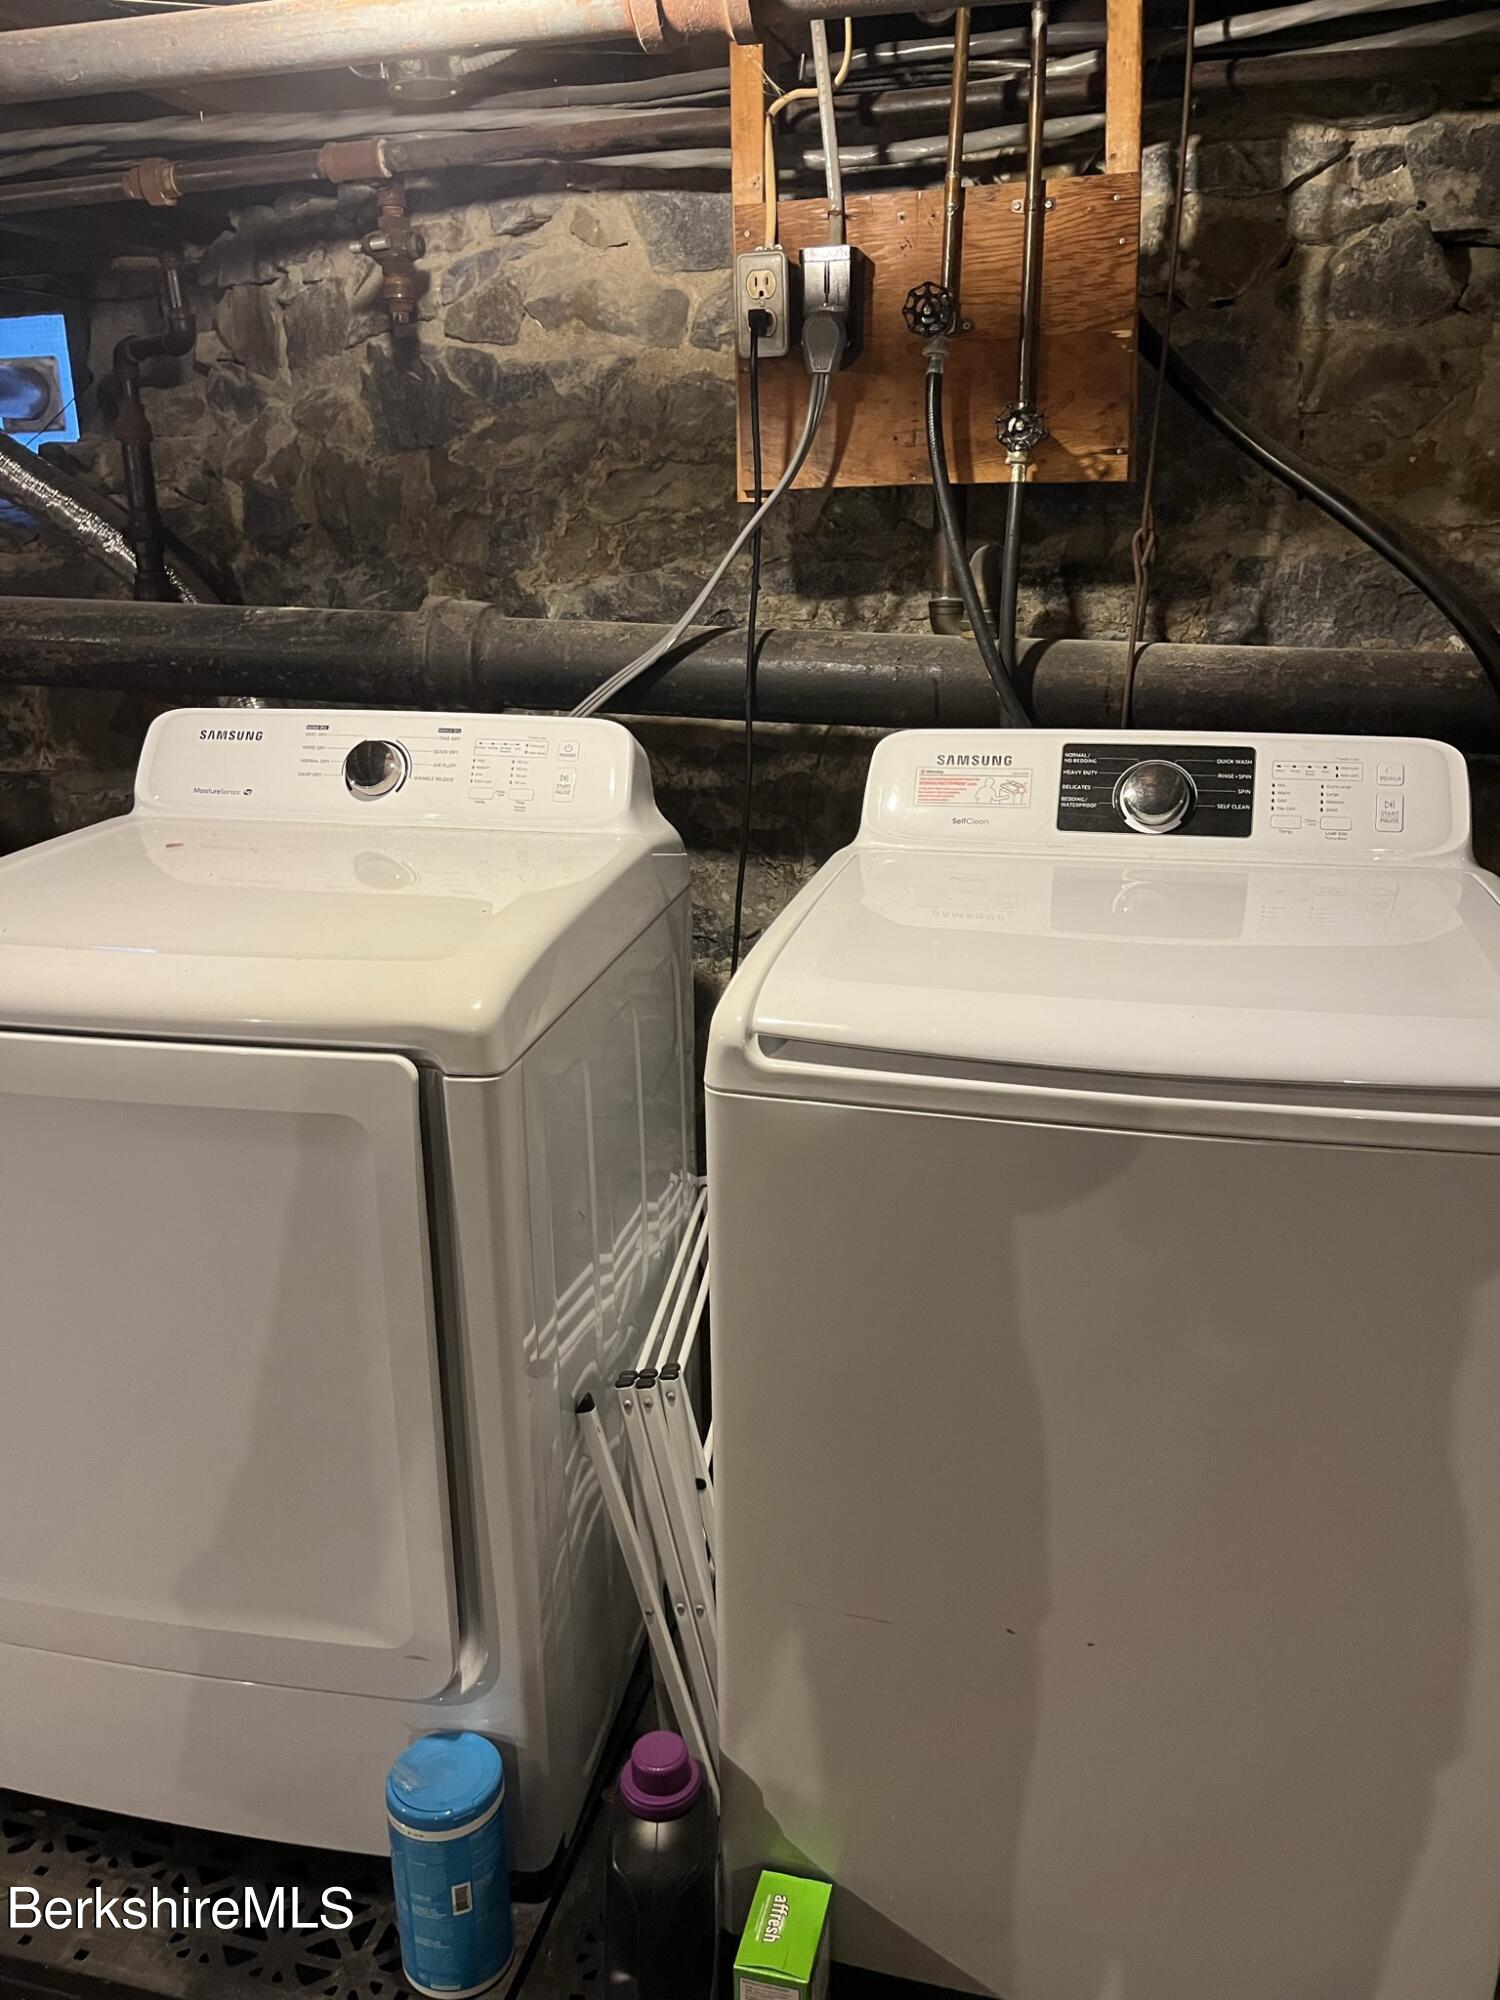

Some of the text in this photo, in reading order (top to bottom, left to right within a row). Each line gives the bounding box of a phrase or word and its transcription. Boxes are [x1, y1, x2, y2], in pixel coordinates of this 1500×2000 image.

[199, 729, 264, 741] SAMSUNG
[936, 754, 1013, 766] SAMSUNG
[952, 817, 990, 825] SelfClean
[762, 1894, 789, 1944] affresh
